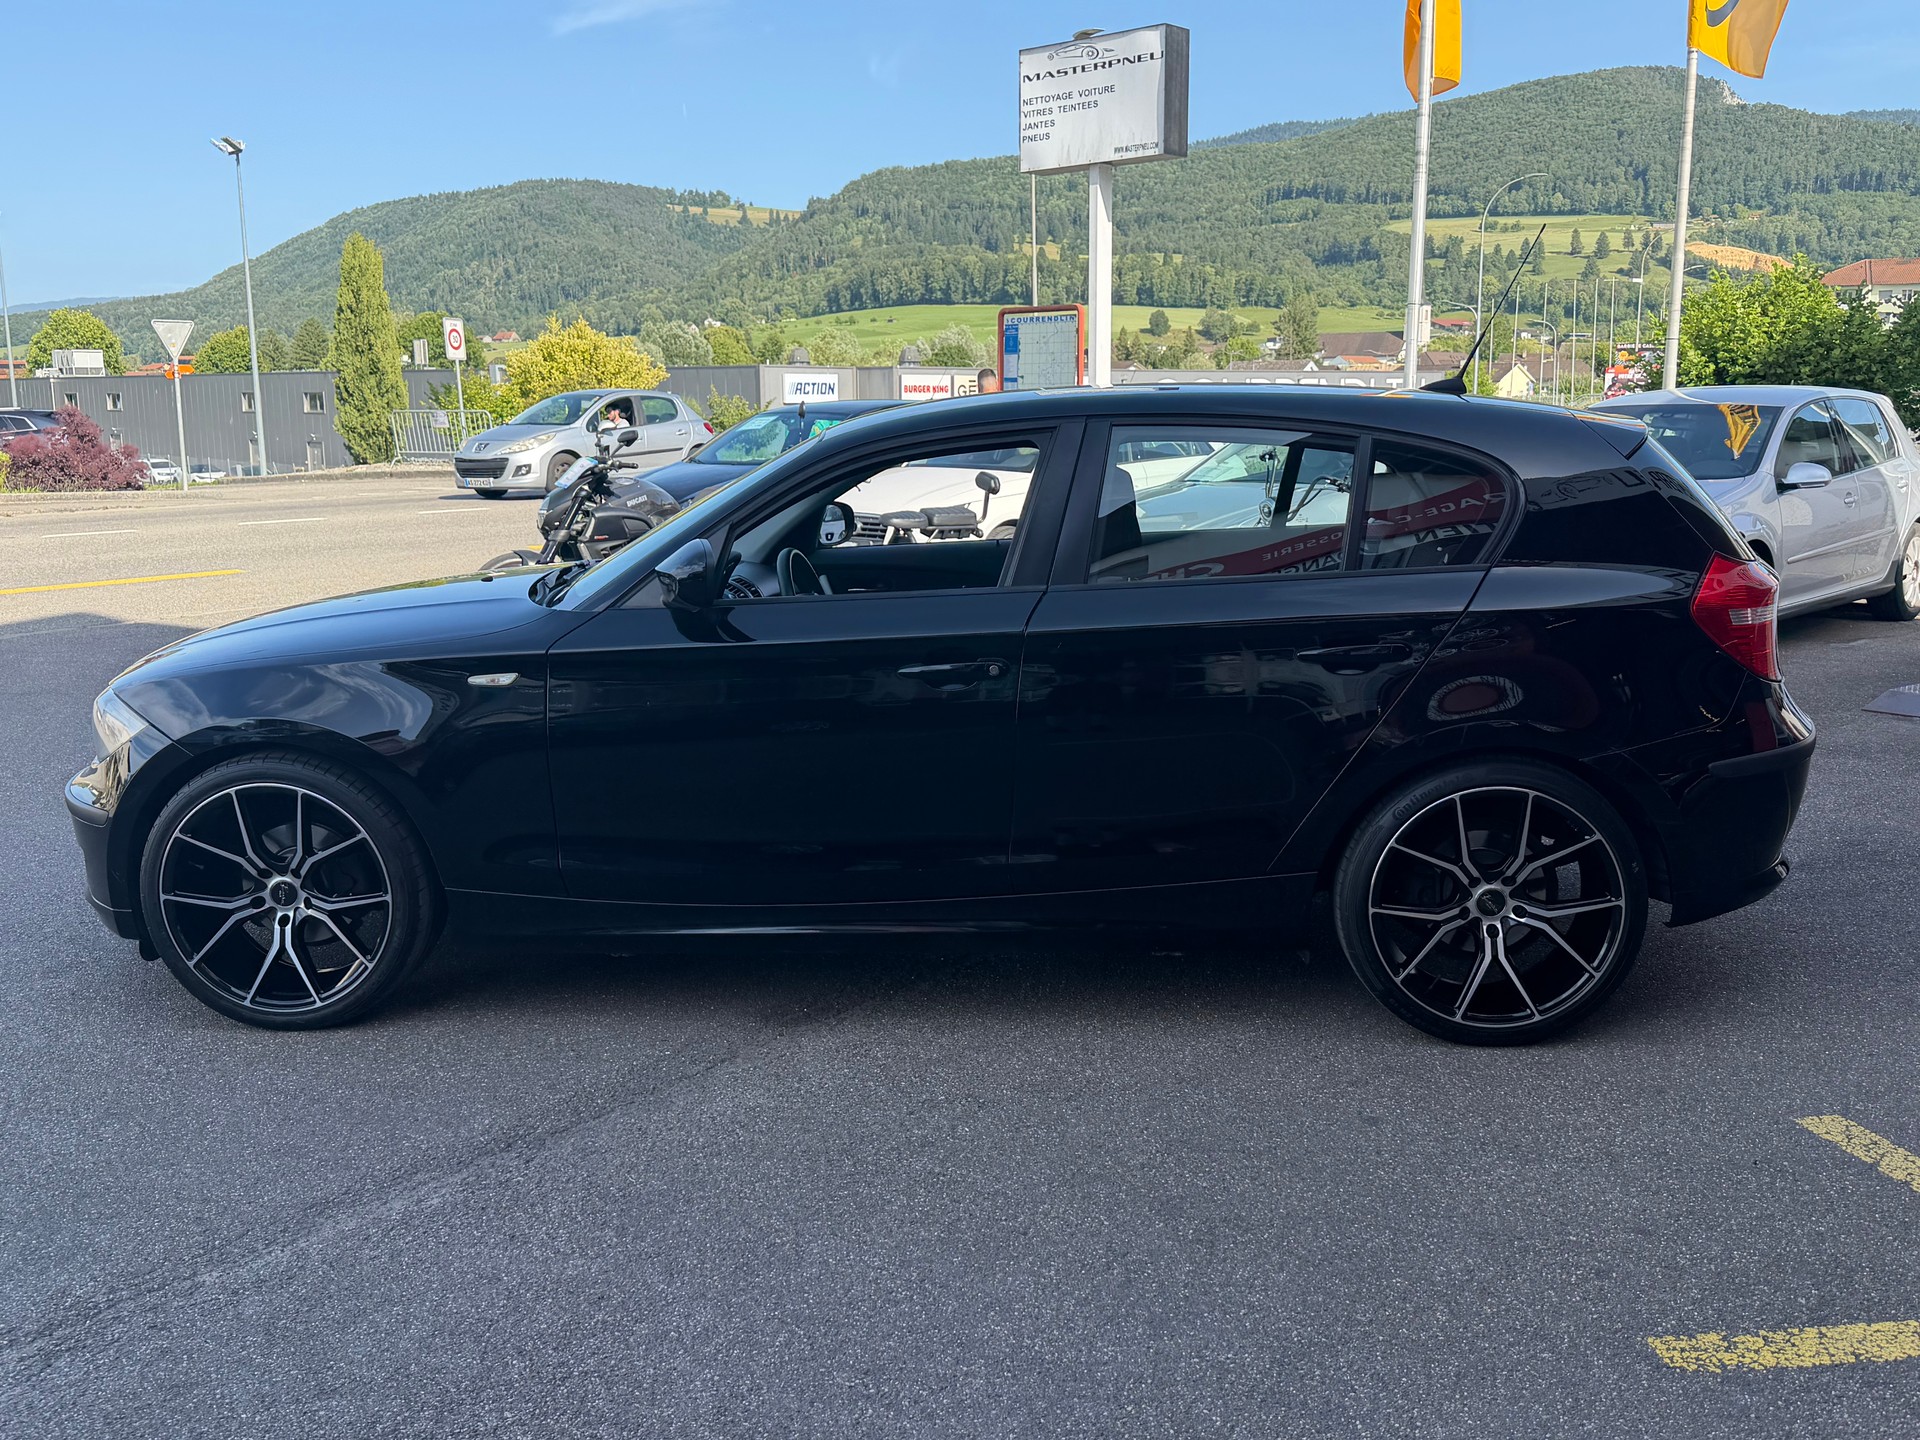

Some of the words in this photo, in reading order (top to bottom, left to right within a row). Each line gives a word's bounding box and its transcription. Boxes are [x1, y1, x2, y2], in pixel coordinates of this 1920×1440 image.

[1023, 50, 1164, 83] MASTERPNEU
[1022, 90, 1074, 106] NETTOYAGE
[1078, 84, 1116, 98] VOITURE
[1022, 105, 1053, 119] VITRES
[1057, 99, 1099, 114] TEINTEES
[1022, 119, 1056, 132] JANTES
[1022, 132, 1051, 144] PNEUS
[1010, 315, 1075, 324] COURRENDLIN
[452, 334, 459, 344] 30
[794, 382, 836, 396] ACTION
[903, 384, 931, 394] BURGER
[932, 384, 949, 394] KING
[626, 494, 648, 508] DUCATI
